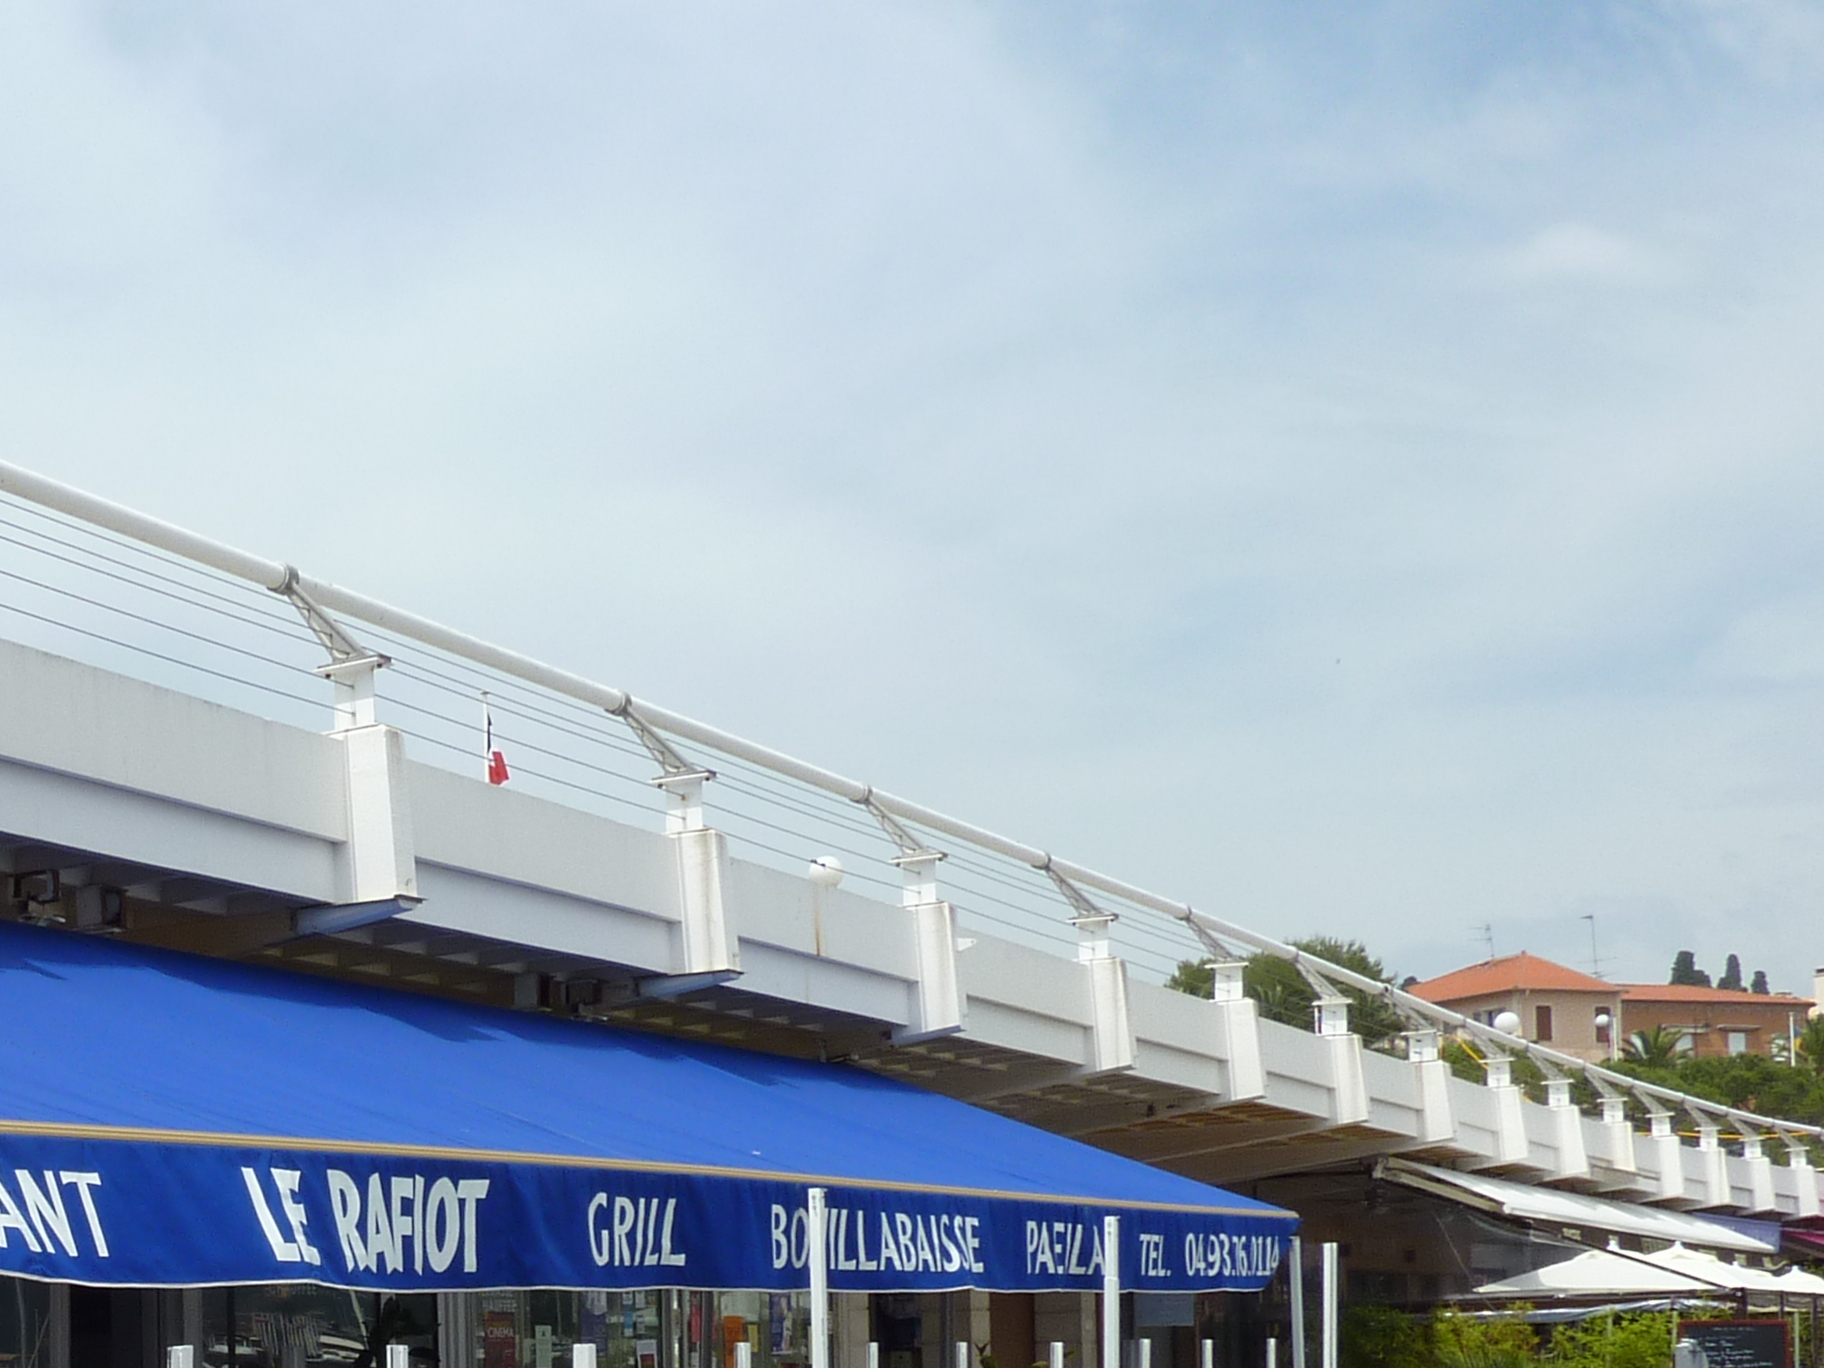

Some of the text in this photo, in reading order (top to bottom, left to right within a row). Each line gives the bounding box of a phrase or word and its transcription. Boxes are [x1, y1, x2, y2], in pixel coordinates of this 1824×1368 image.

[241, 1166, 321, 1264] LE
[326, 1166, 490, 1275] RAFIOT
[588, 1191, 687, 1268] GRILL
[771, 1203, 985, 1274] BOILLABAISSE
